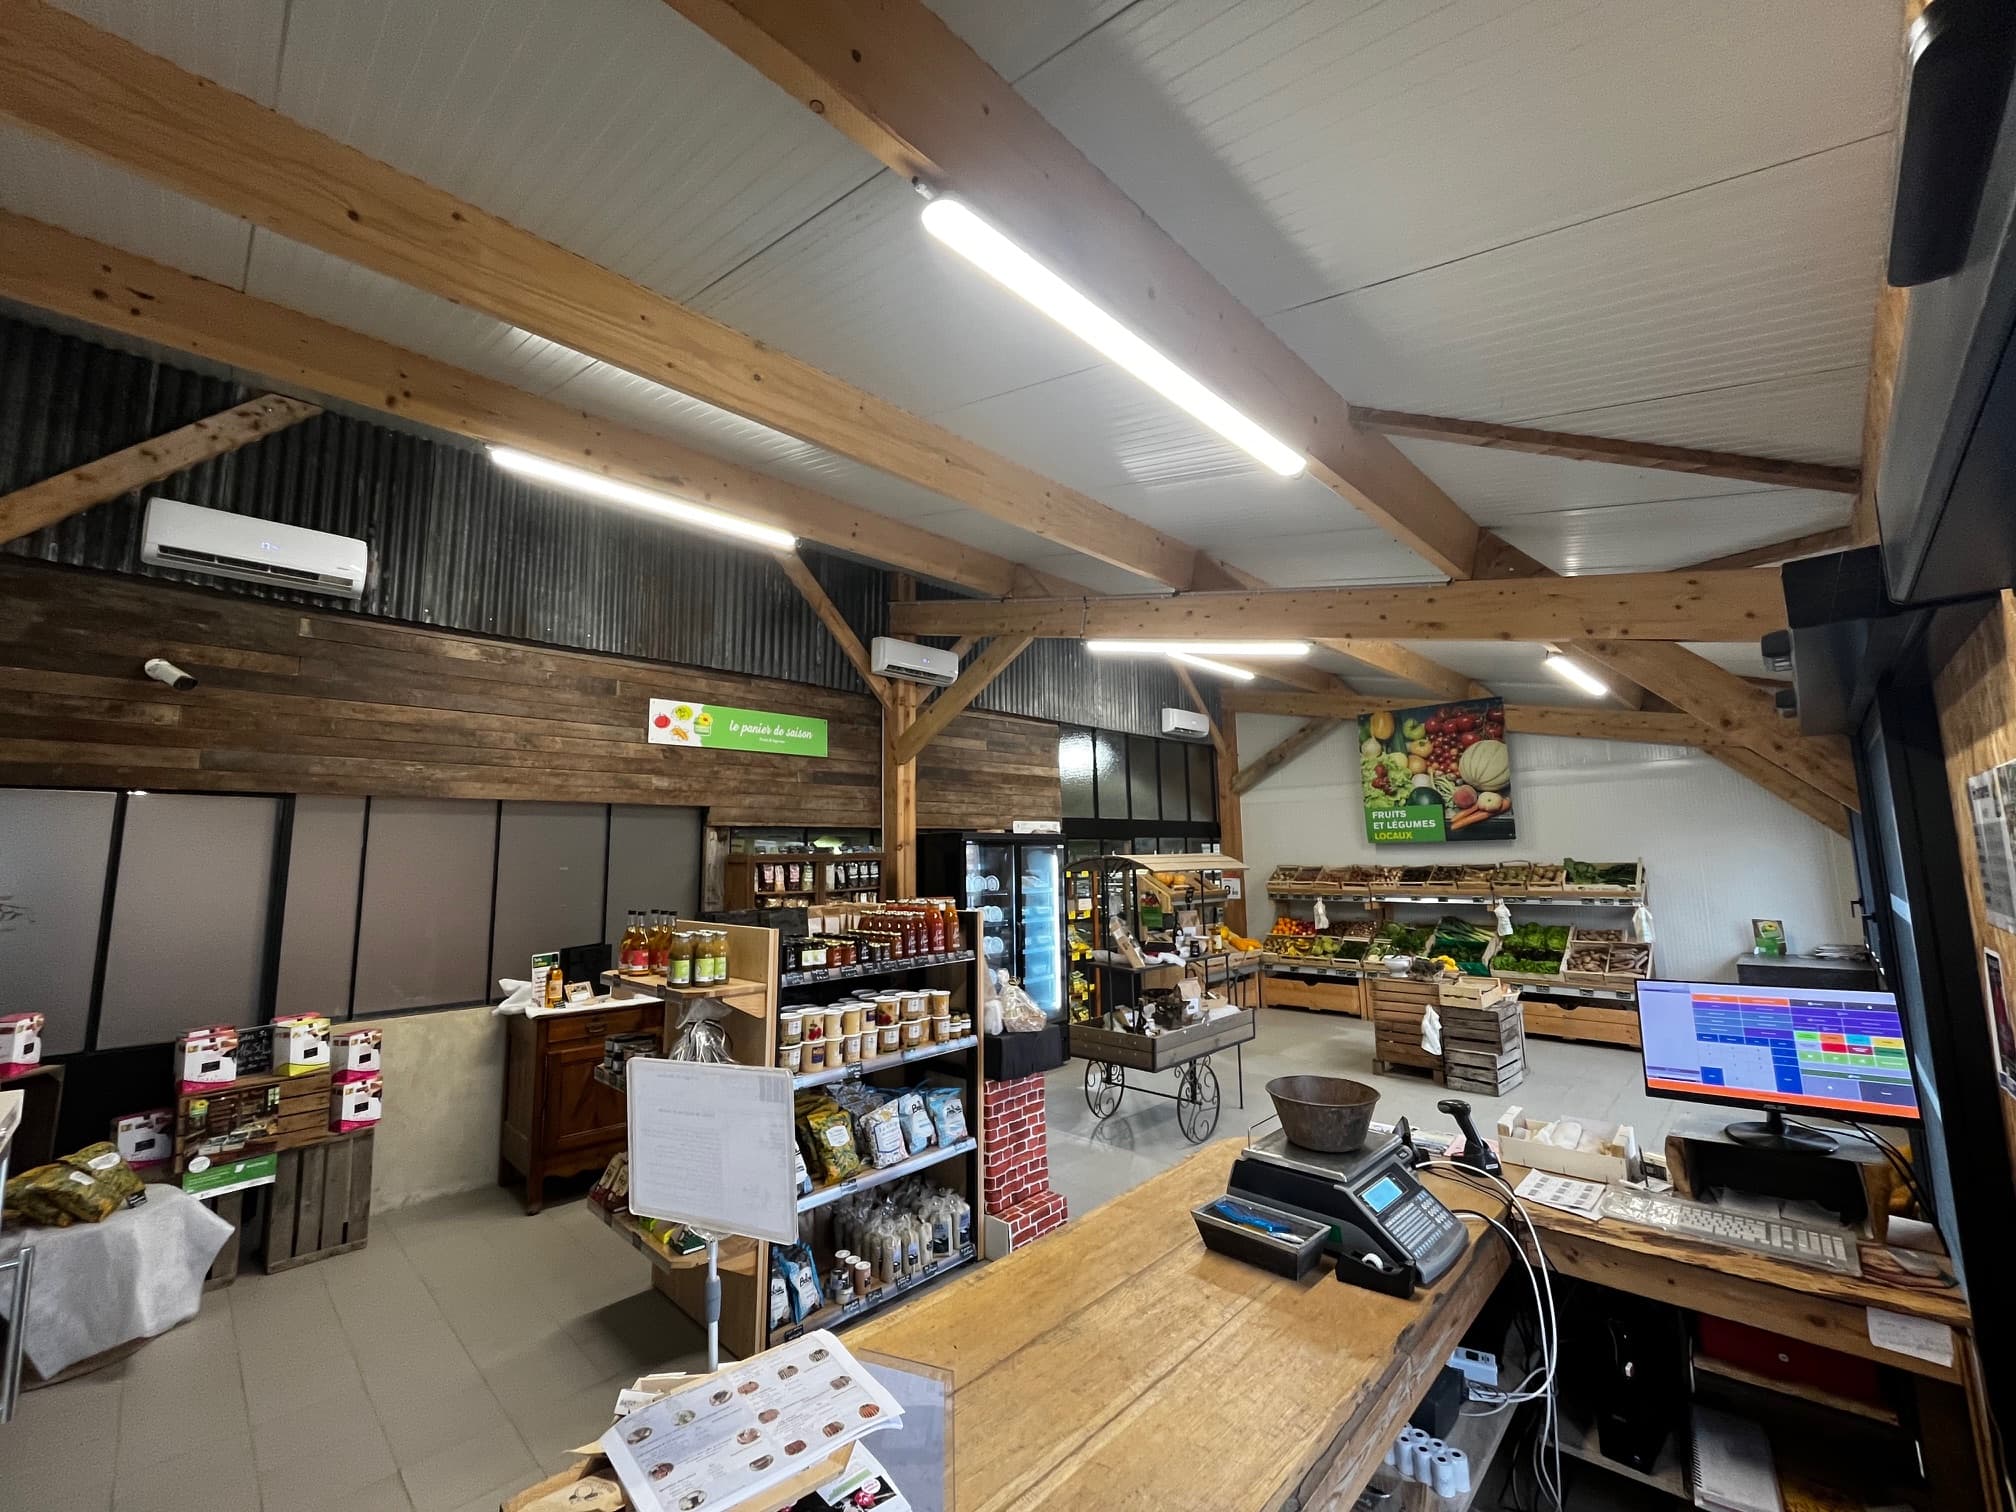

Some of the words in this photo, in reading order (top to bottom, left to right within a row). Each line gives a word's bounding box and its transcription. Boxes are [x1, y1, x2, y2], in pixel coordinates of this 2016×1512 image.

[740, 723, 772, 737] panier
[773, 724, 785, 736] de
[785, 727, 813, 739] saison
[1372, 810, 1407, 819] FRUITS
[1373, 821, 1384, 830] ET
[1387, 819, 1436, 829] LÉGUMES
[1374, 831, 1413, 840] LOCAUX
